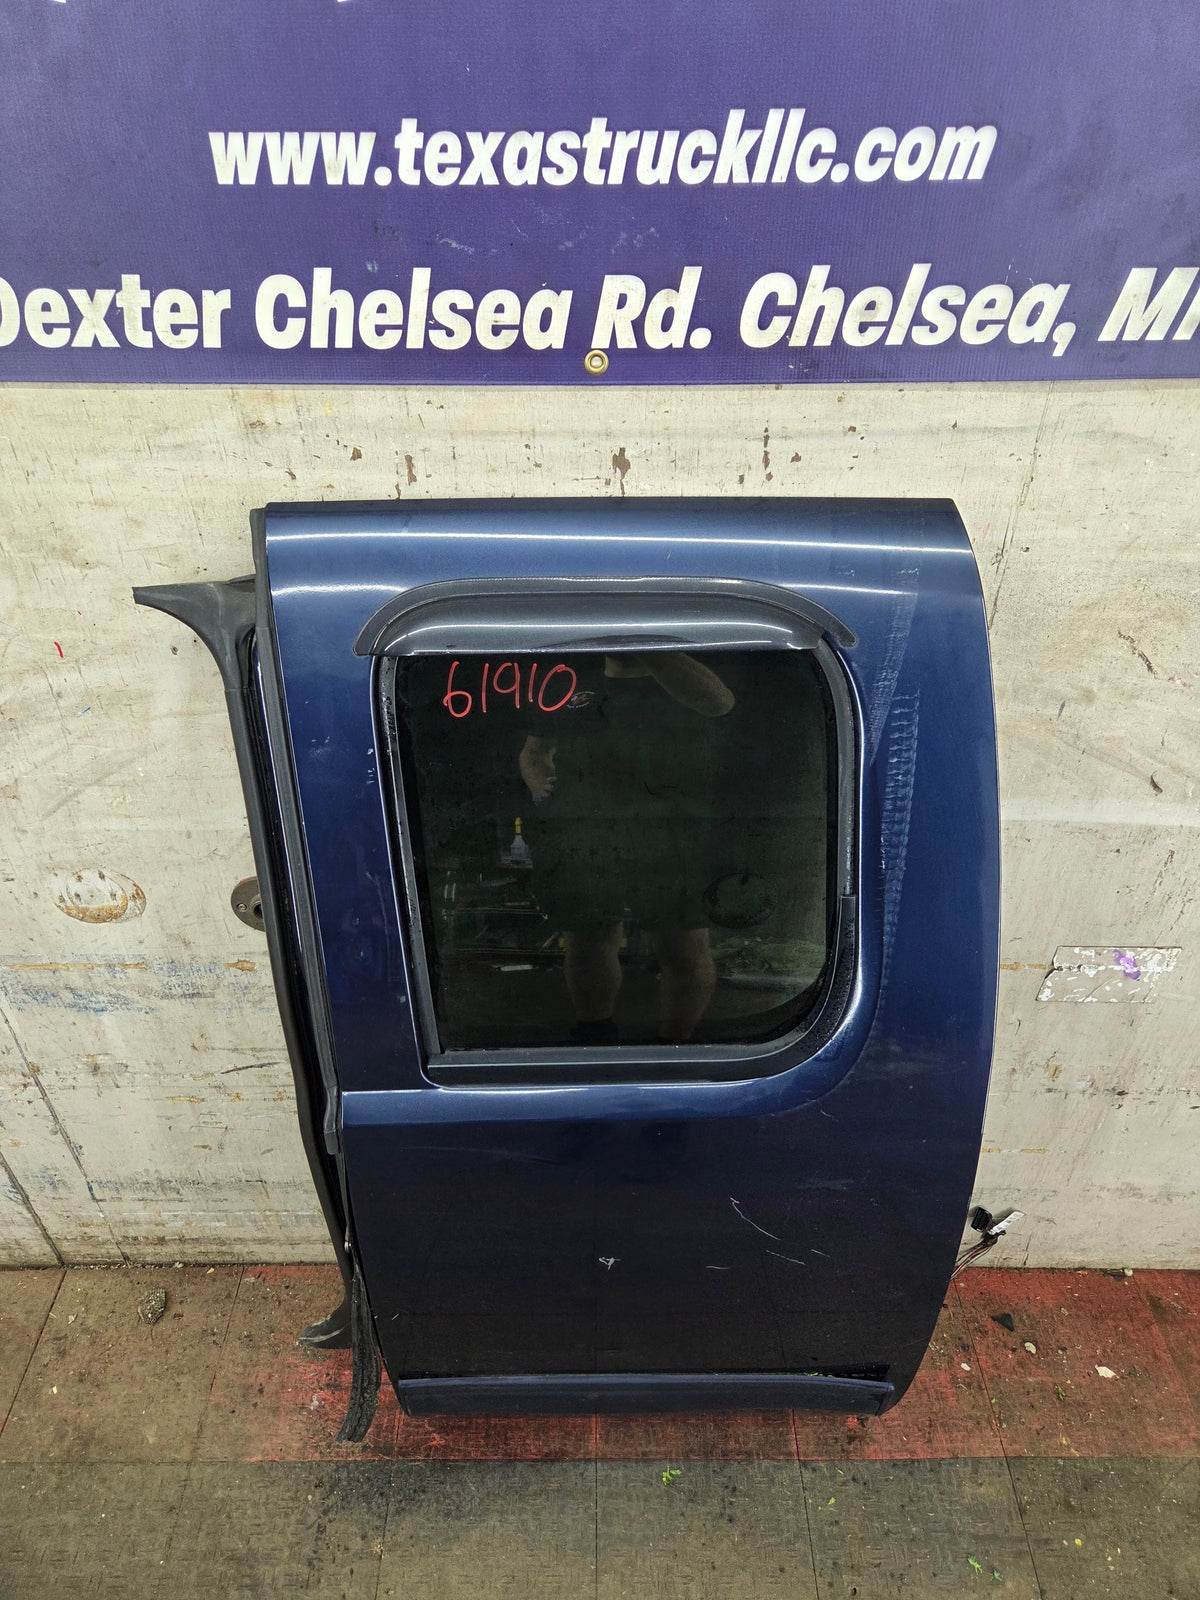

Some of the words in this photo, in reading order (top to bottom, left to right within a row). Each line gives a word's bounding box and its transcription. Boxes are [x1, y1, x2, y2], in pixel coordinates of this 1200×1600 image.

[208, 108, 997, 186] www.texastruckllc.com
[255, 267, 574, 350] Chelsea
[591, 266, 711, 350] Rd.
[740, 263, 1076, 357] Chelsea,
[443, 661, 577, 718] 61910
